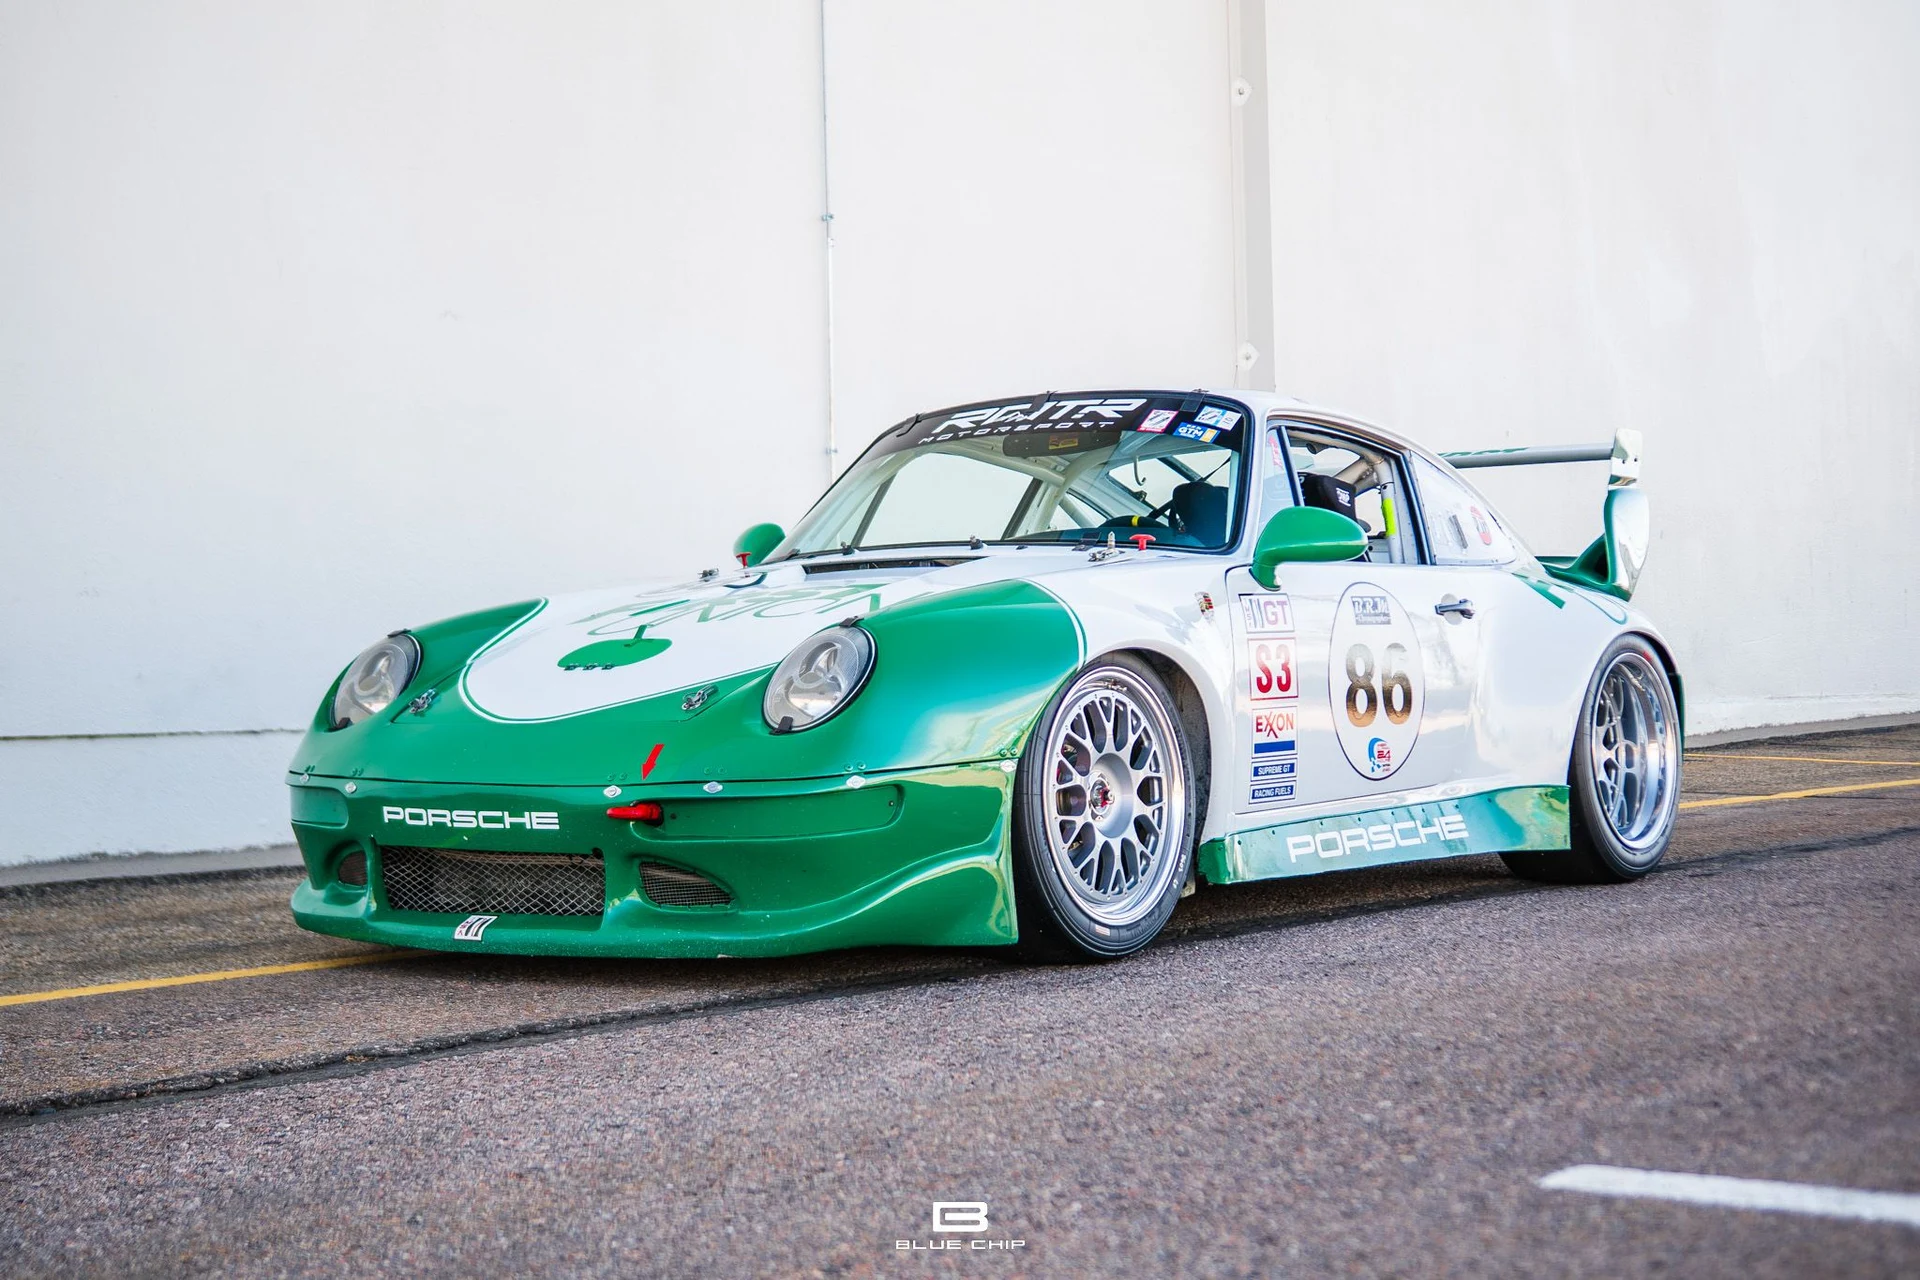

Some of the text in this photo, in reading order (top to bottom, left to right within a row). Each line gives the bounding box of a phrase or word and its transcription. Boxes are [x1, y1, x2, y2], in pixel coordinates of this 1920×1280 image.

[918, 421, 1114, 444] MOTORSPORT
[1264, 600, 1288, 625] GT
[1255, 644, 1292, 694] S3
[1346, 643, 1412, 728] 86
[1255, 712, 1295, 739] EXXON
[1258, 765, 1291, 775] SUPREME GT
[1254, 786, 1291, 798] RACING FUELS
[383, 806, 560, 830] PORSCHE
[1287, 814, 1470, 863] PORSCHE
